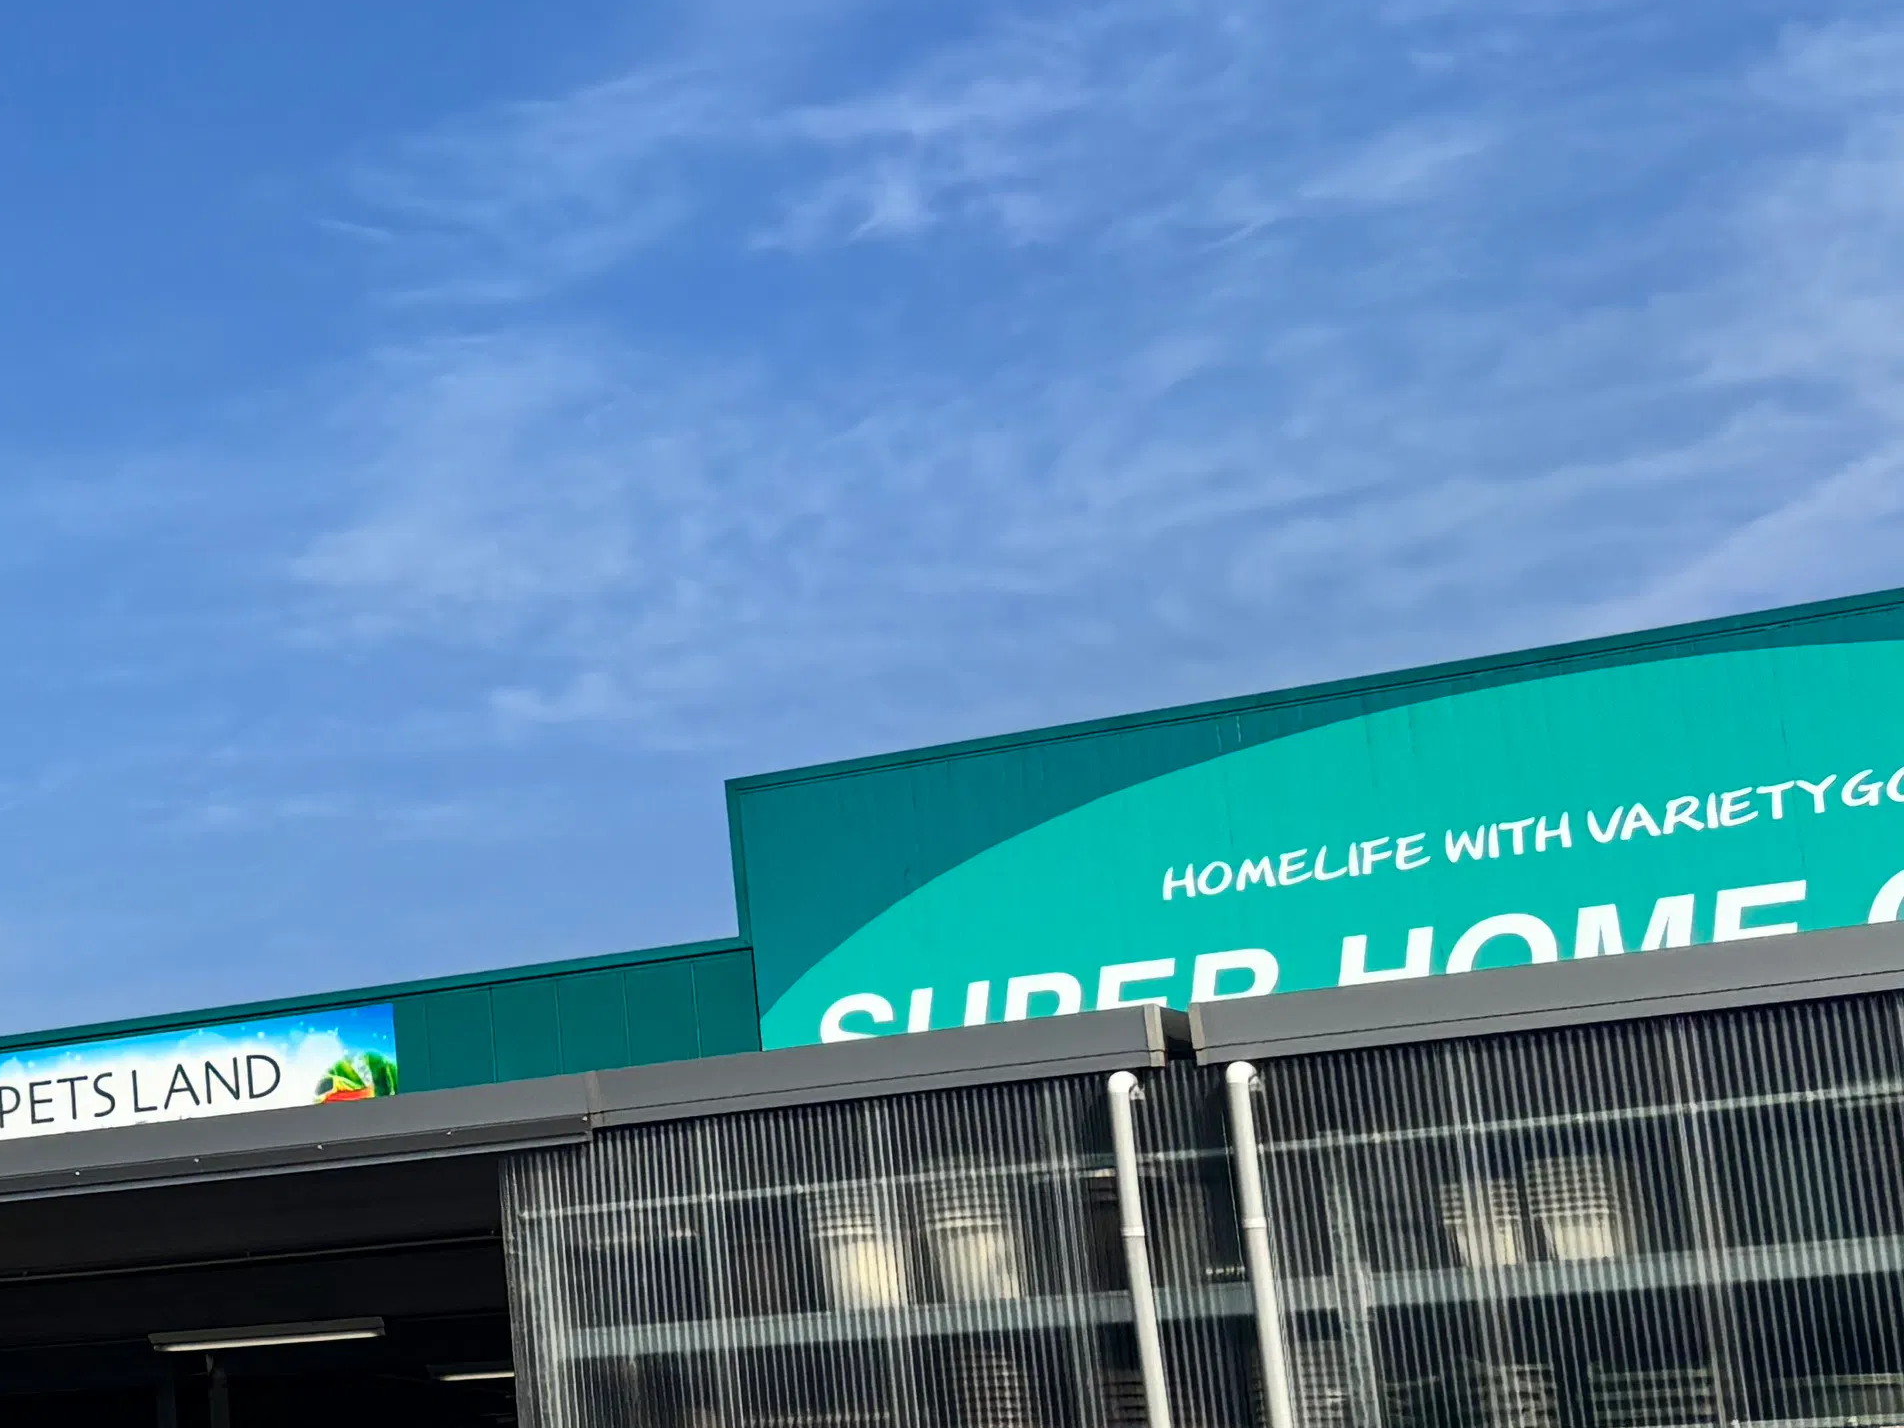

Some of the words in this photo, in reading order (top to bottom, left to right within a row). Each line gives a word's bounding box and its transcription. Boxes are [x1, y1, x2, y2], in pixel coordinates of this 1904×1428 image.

[1163, 832, 1431, 900] HOMELIFE
[1445, 811, 1572, 863] WITH
[132, 1054, 281, 1113] LAND
